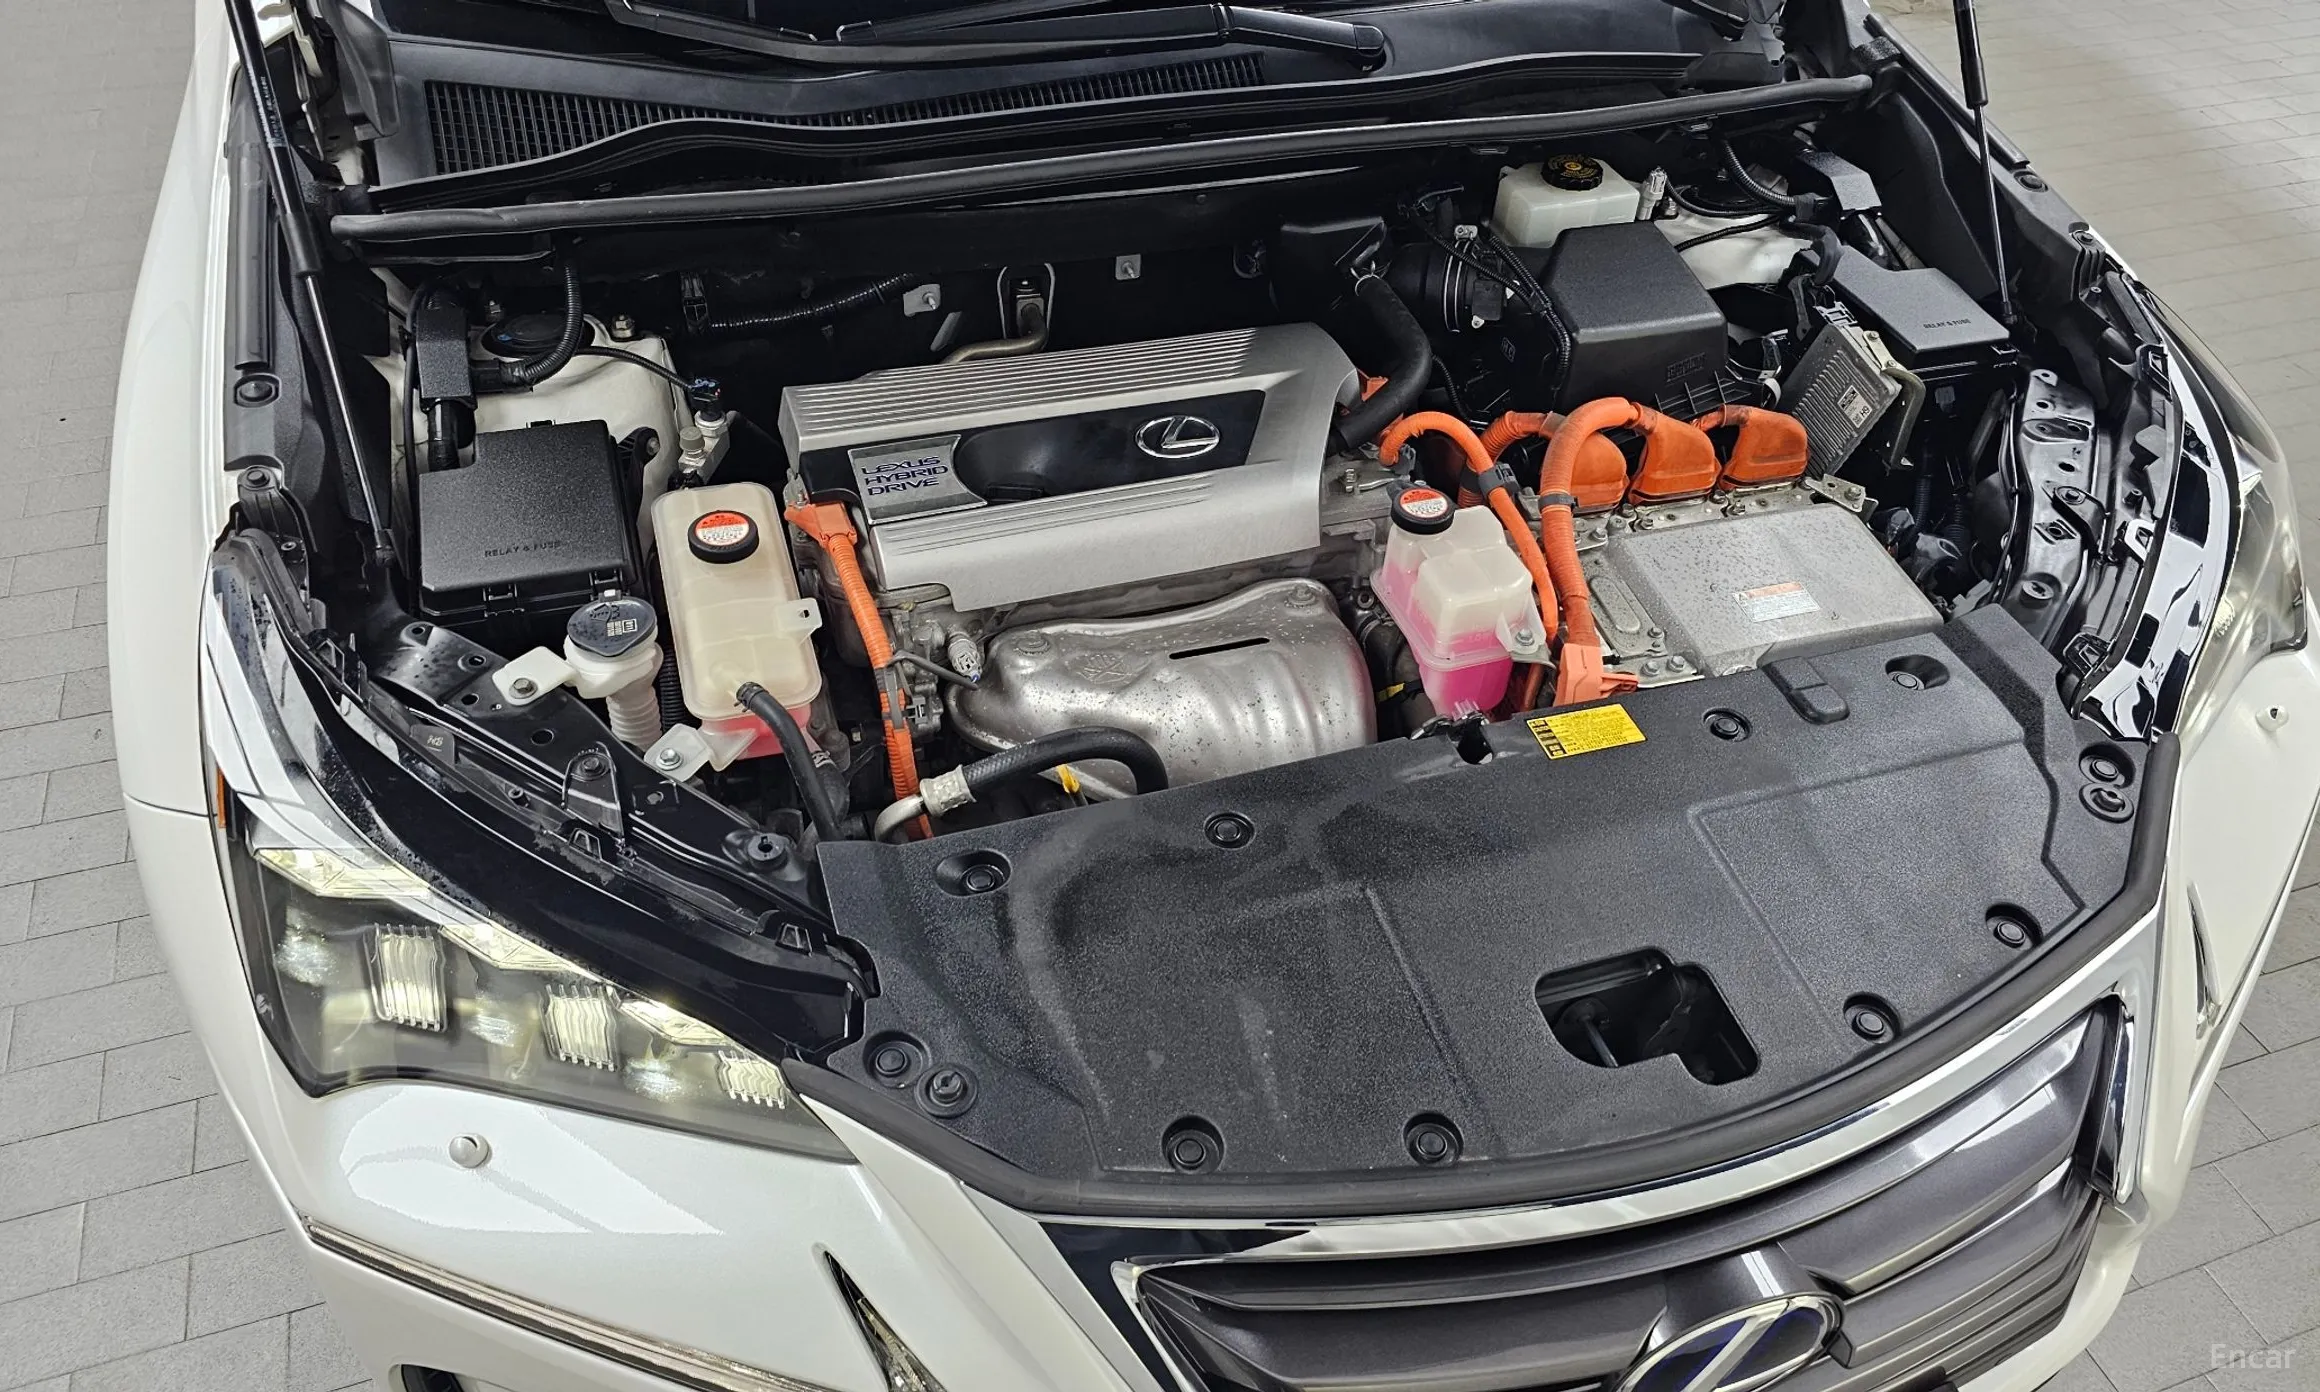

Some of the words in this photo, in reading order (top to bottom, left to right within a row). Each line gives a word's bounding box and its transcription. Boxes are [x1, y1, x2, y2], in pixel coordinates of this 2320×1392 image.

[861, 456, 941, 475] LEXUS
[864, 465, 949, 486] HYBRID
[867, 477, 940, 496] DRIVE
[484, 544, 519, 557] RELAY
[533, 540, 561, 551] FUSE
